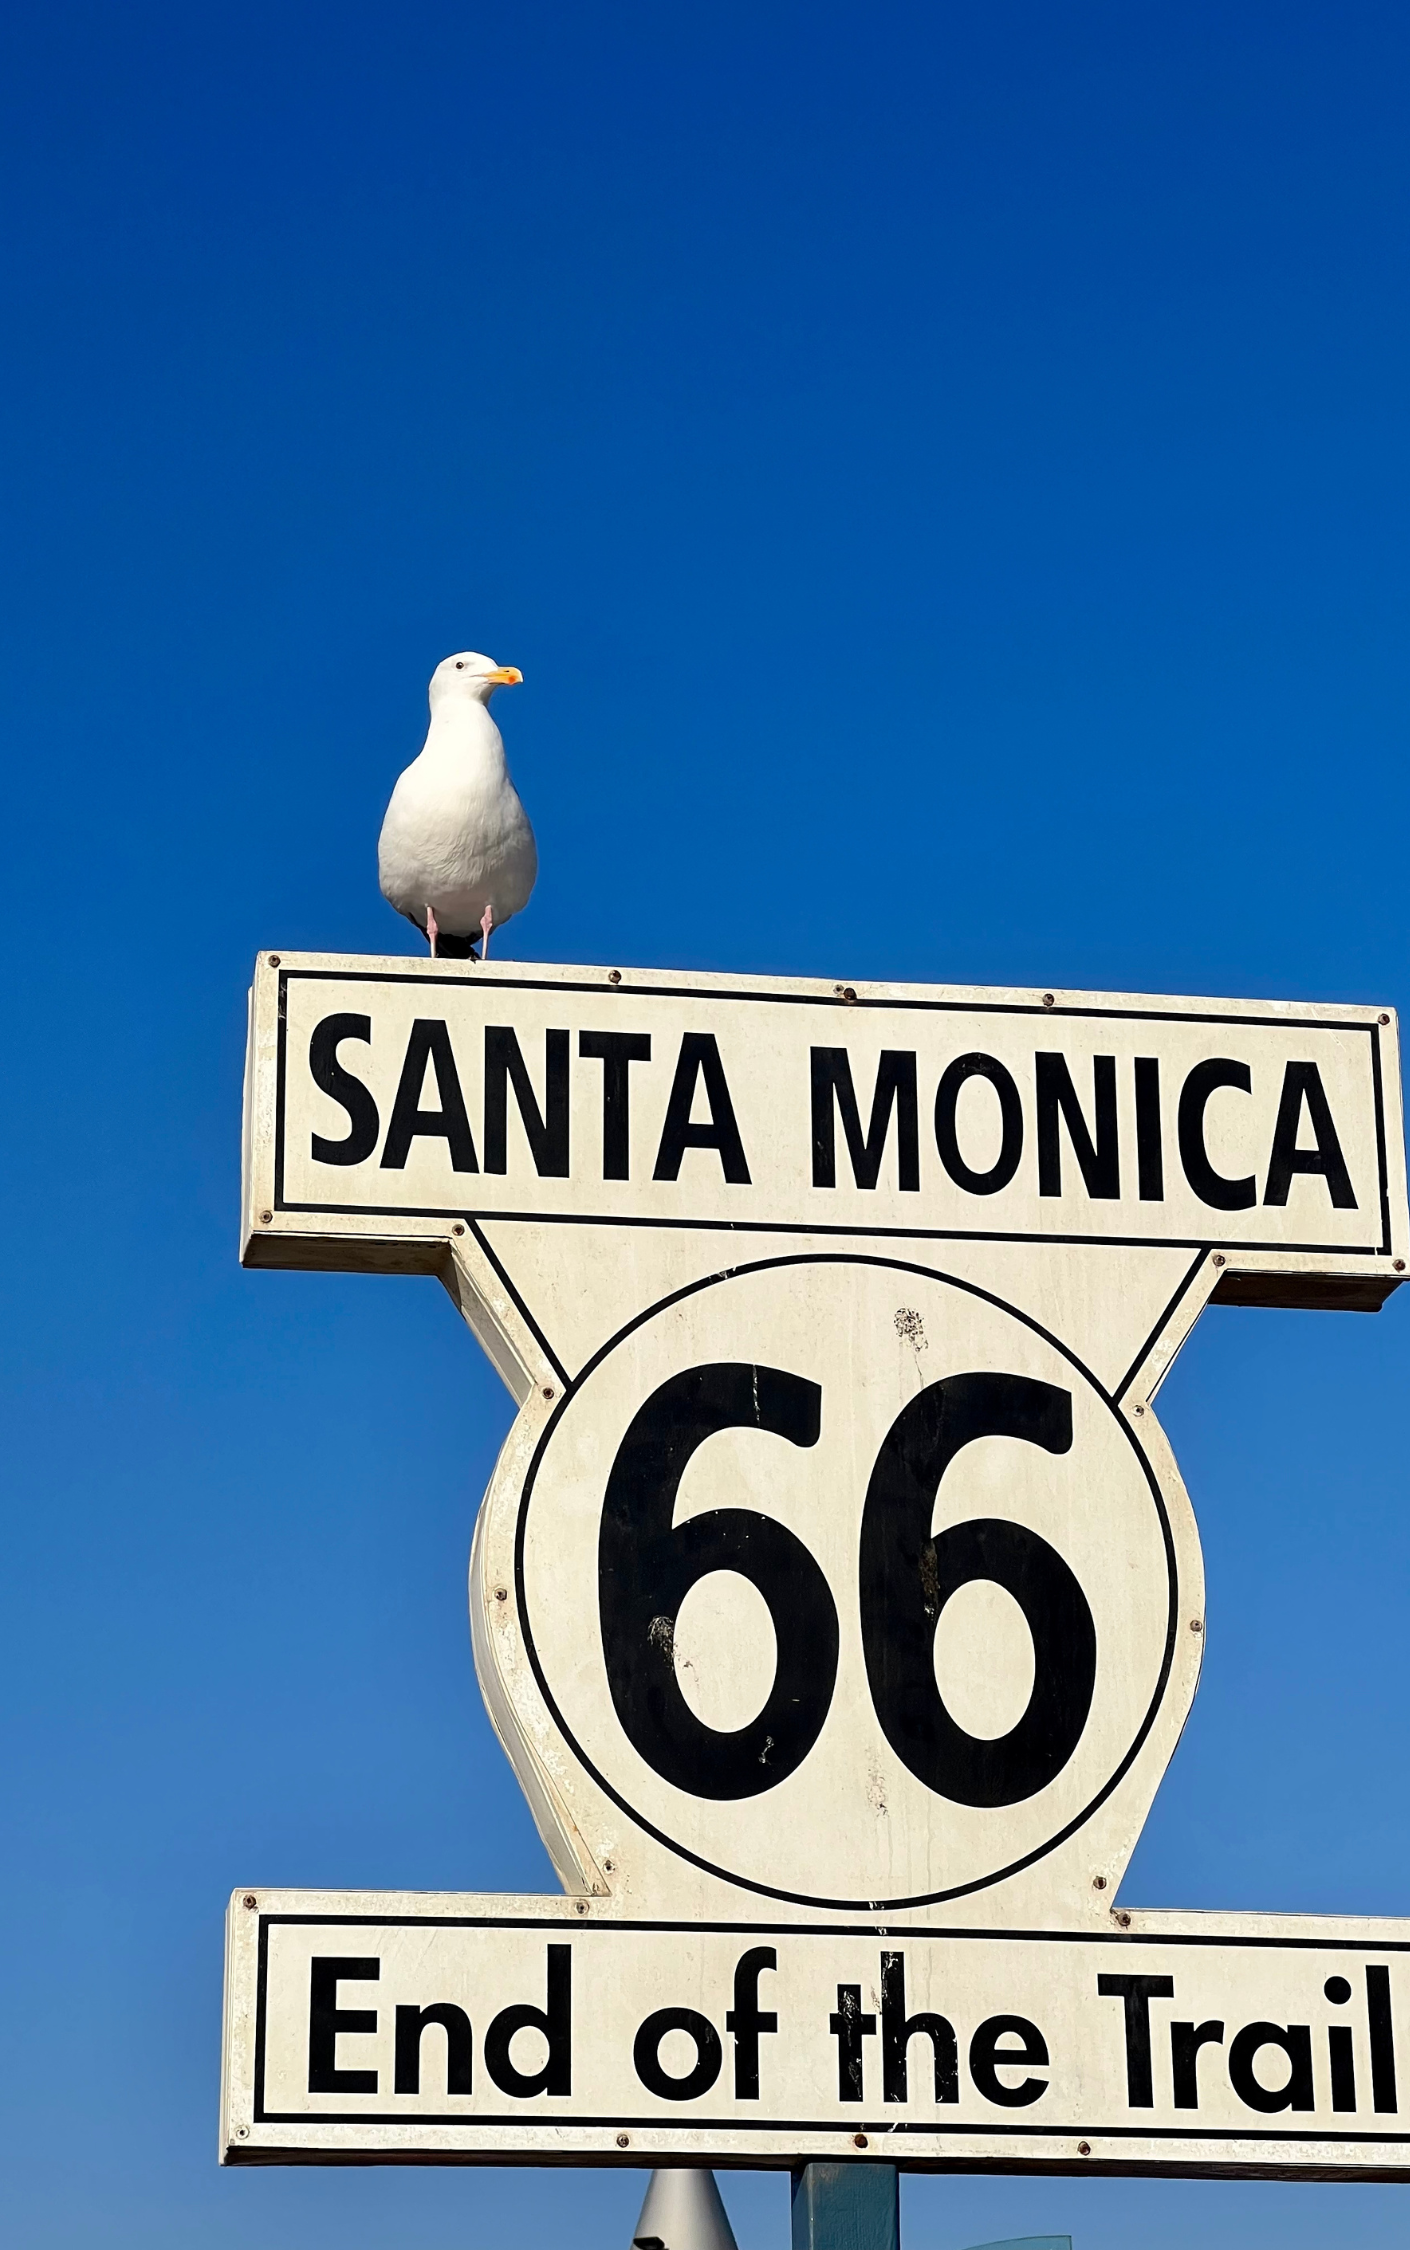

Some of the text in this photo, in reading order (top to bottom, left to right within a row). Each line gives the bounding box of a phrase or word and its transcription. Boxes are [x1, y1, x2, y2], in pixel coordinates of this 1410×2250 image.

[310, 1013, 1359, 1211] SANTA MONICA
[597, 1361, 1097, 1809] 66
[308, 1943, 1399, 2114] End of the Trail
